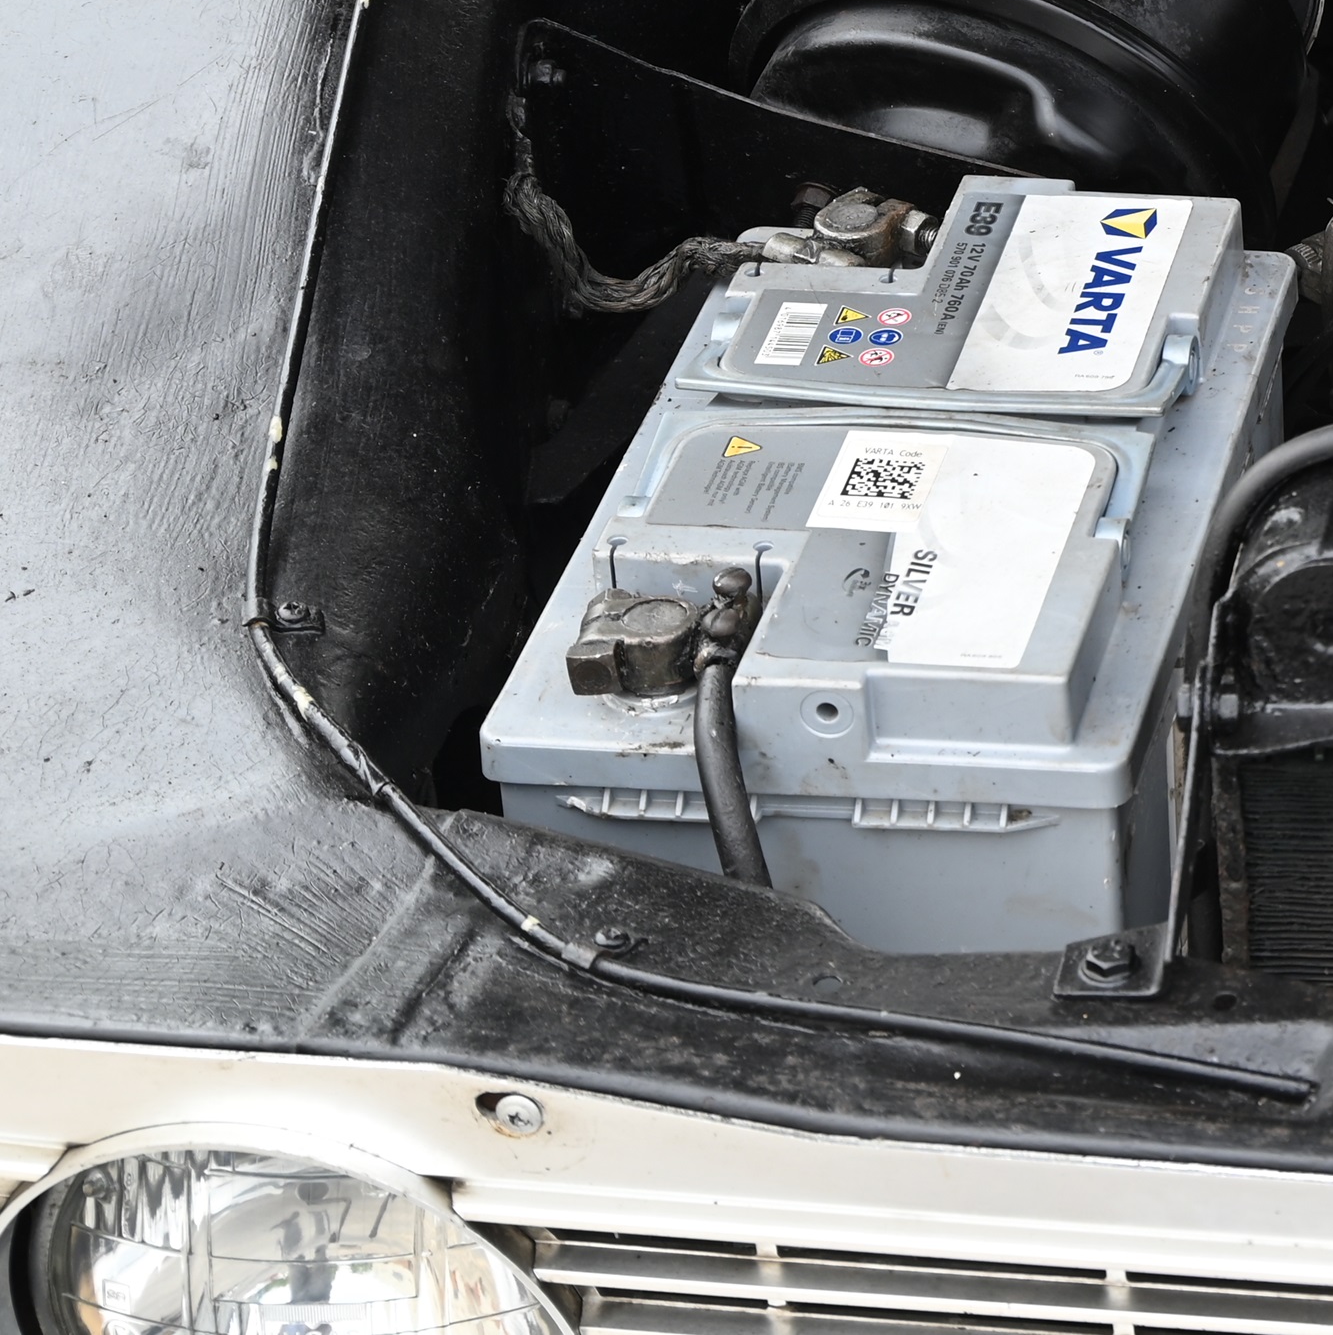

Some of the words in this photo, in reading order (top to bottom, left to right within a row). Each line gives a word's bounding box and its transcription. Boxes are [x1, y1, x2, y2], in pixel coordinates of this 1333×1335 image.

[964, 201, 1004, 237] E39
[954, 242, 968, 255] 570
[967, 242, 987, 263] 12V
[949, 256, 962, 268] 901
[941, 269, 956, 283] 076
[953, 265, 977, 291] 70Ah
[942, 294, 965, 321] 760A
[1057, 245, 1144, 355] VARTA
[865, 447, 894, 456] VARTA
[899, 449, 923, 458] Code
[890, 549, 938, 617] SILVER
[855, 572, 900, 647] DYNAMIC
